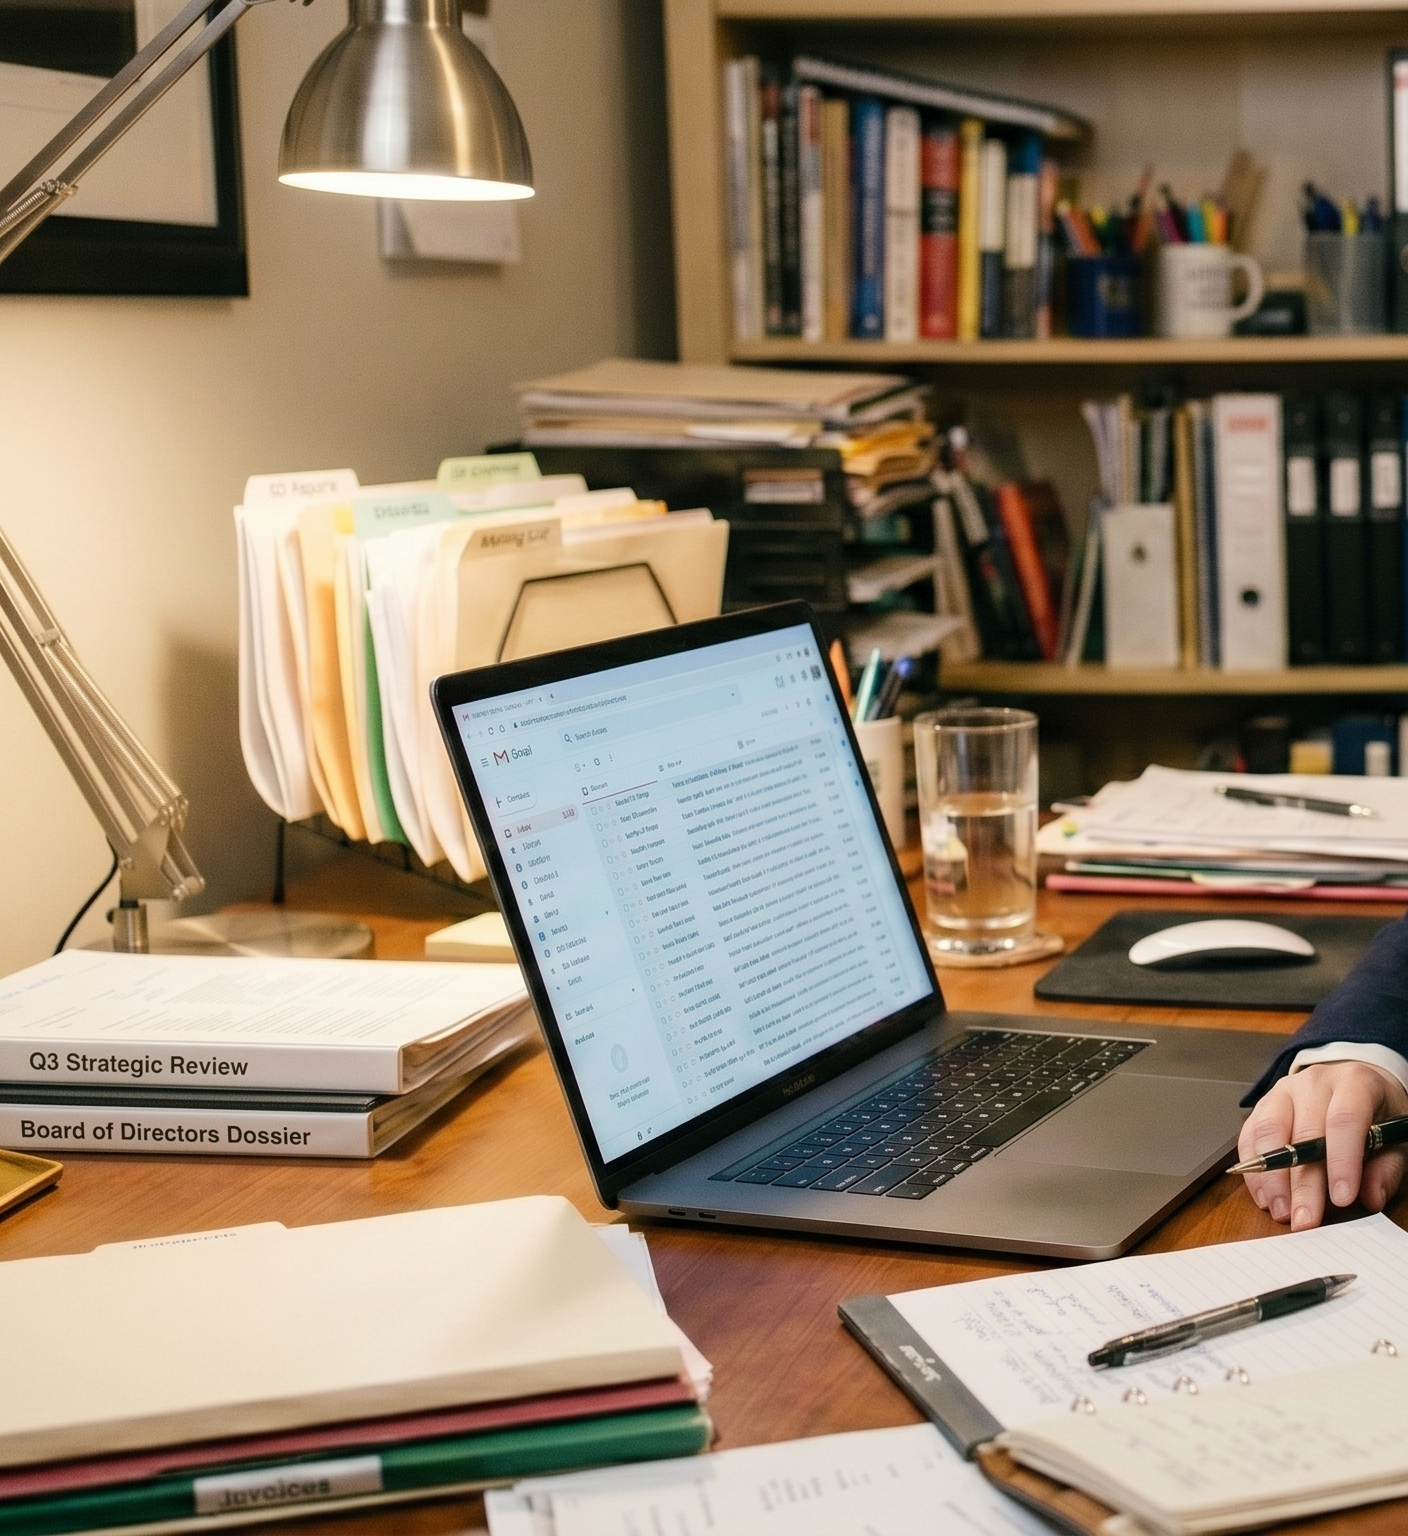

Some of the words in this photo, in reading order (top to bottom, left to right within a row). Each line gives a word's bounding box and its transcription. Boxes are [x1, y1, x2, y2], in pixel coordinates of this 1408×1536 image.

[29, 1052, 59, 1072] Q3
[66, 1053, 163, 1078] Strategic
[170, 1056, 249, 1076] Review
[20, 1120, 86, 1140] Board
[93, 1122, 114, 1140] of
[121, 1122, 220, 1143] Directors
[227, 1126, 311, 1146] Dossier
